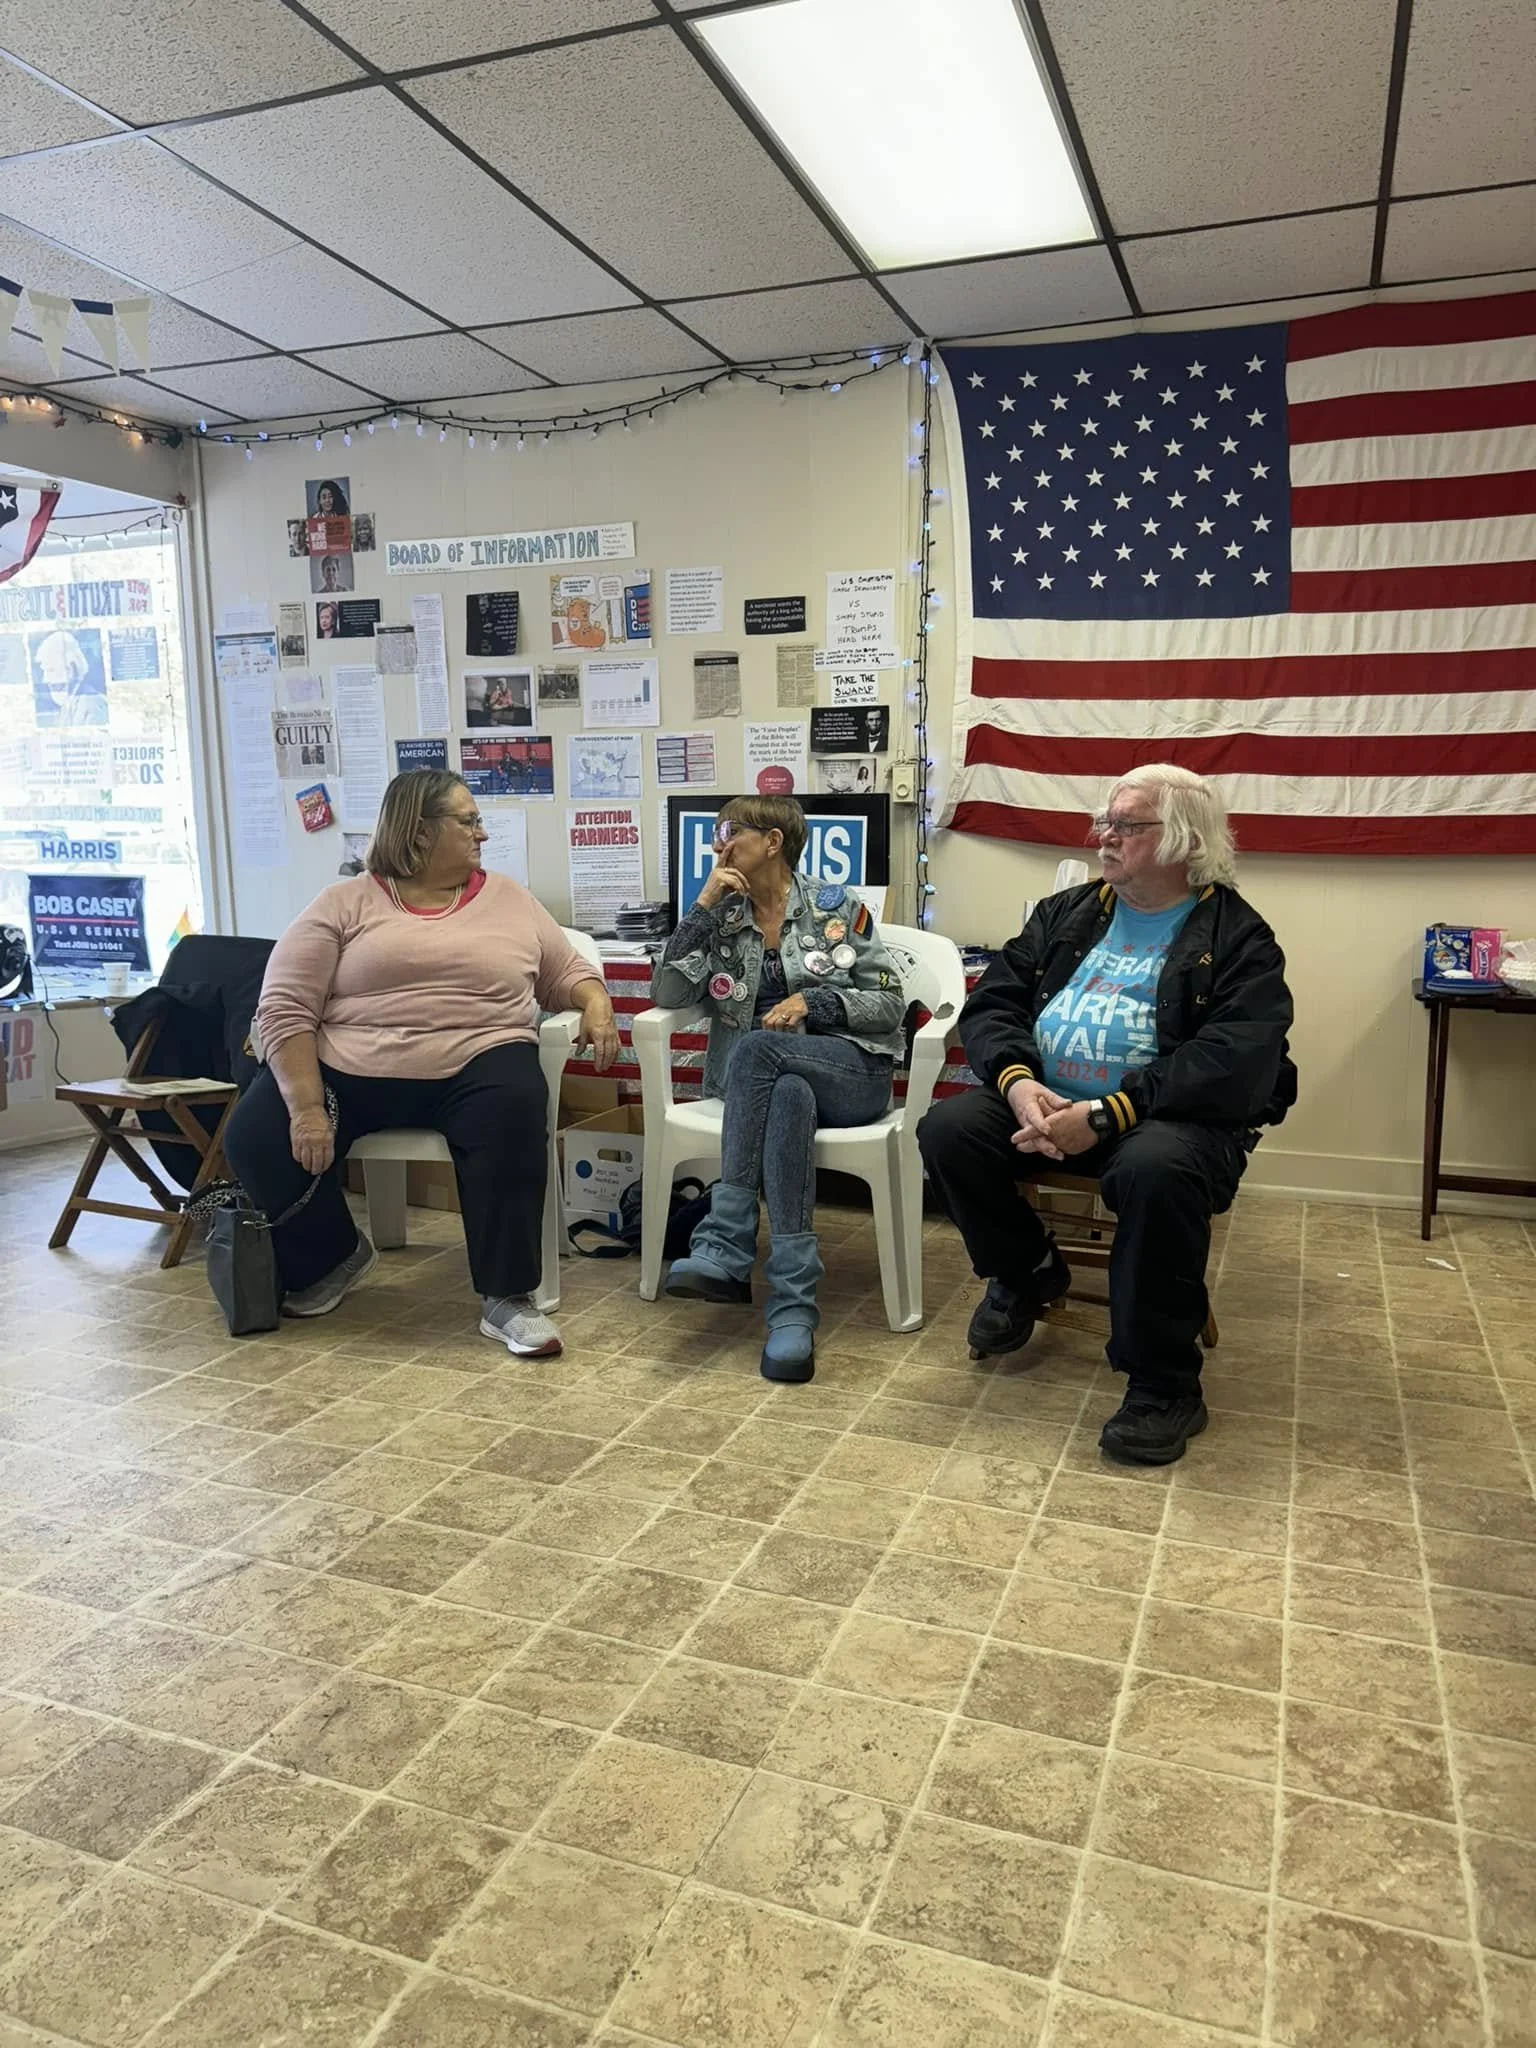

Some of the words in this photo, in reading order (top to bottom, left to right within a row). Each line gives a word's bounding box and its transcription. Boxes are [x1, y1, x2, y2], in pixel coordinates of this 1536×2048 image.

[388, 543, 441, 567] BOARD
[447, 542, 464, 563] OF
[470, 529, 600, 565] INFORMATION
[848, 600, 861, 608] VS
[833, 675, 857, 686] TAKE
[860, 673, 876, 683] THE
[835, 686, 873, 697] SWAMP
[275, 725, 333, 745] GUILTY
[399, 749, 444, 759] AMERICAN
[575, 810, 632, 825] ATTENTION
[570, 826, 639, 846] FARMERS
[41, 842, 117, 859] HARRIS
[33, 895, 74, 914] BOB
[75, 896, 137, 917] CASEY
[36, 925, 62, 936] U.S.
[85, 926, 140, 938] SENATE
[1083, 976, 1125, 996] for
[1040, 988, 1157, 1030] ARRI
[1035, 1020, 1159, 1065] WALZ
[1056, 1060, 1109, 1083] 2024
